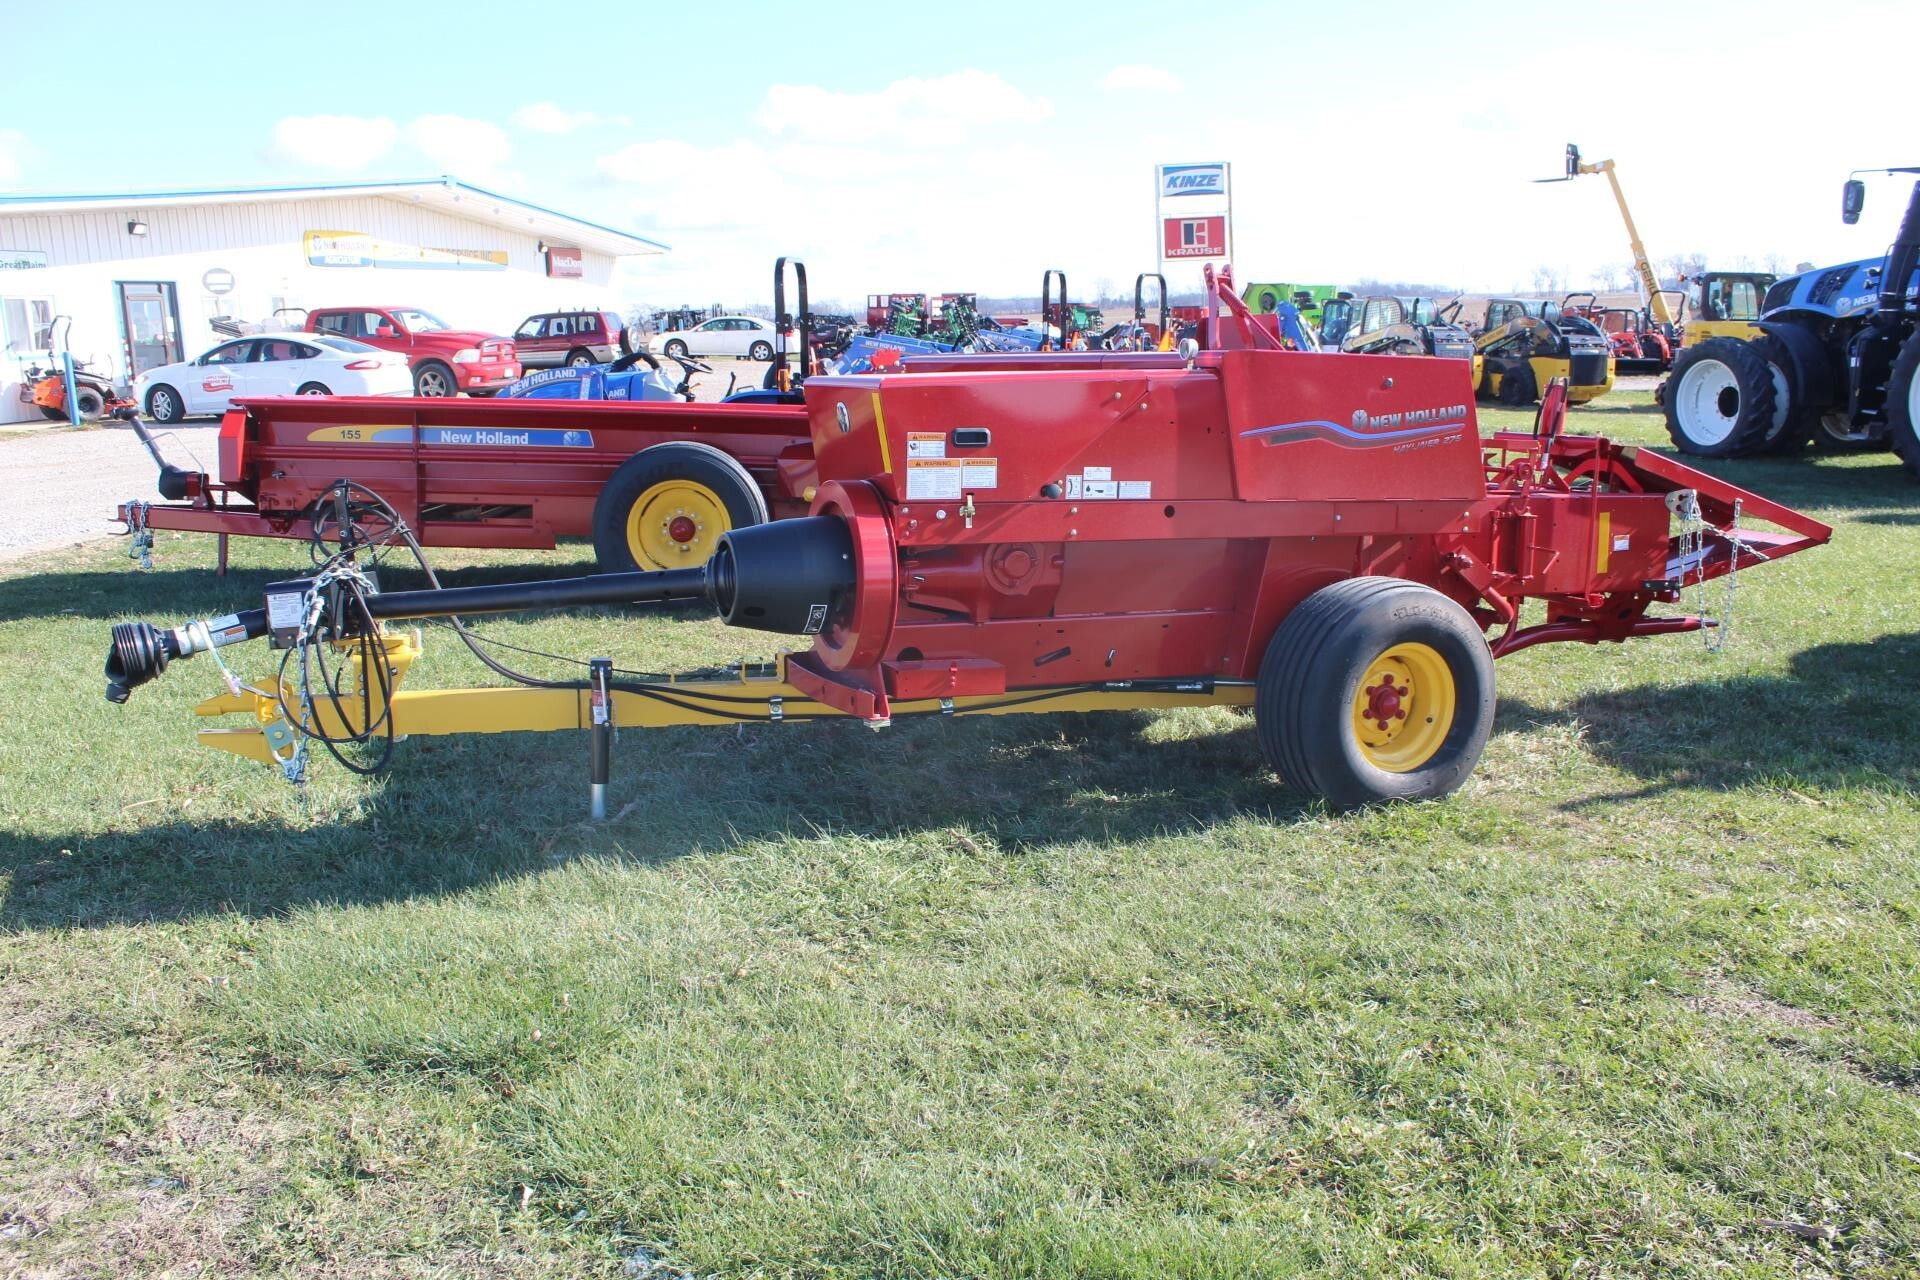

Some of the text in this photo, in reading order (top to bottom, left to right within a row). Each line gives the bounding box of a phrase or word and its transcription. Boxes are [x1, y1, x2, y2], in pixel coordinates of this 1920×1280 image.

[1166, 174, 1219, 188] KINZE
[1168, 247, 1224, 256] KRAUSE
[1853, 294, 1878, 306] NEW
[510, 369, 577, 395] NEW HOLLAND
[1370, 405, 1467, 429] NEW HOLLAND
[340, 430, 361, 440] 155
[441, 430, 529, 445] New Holland
